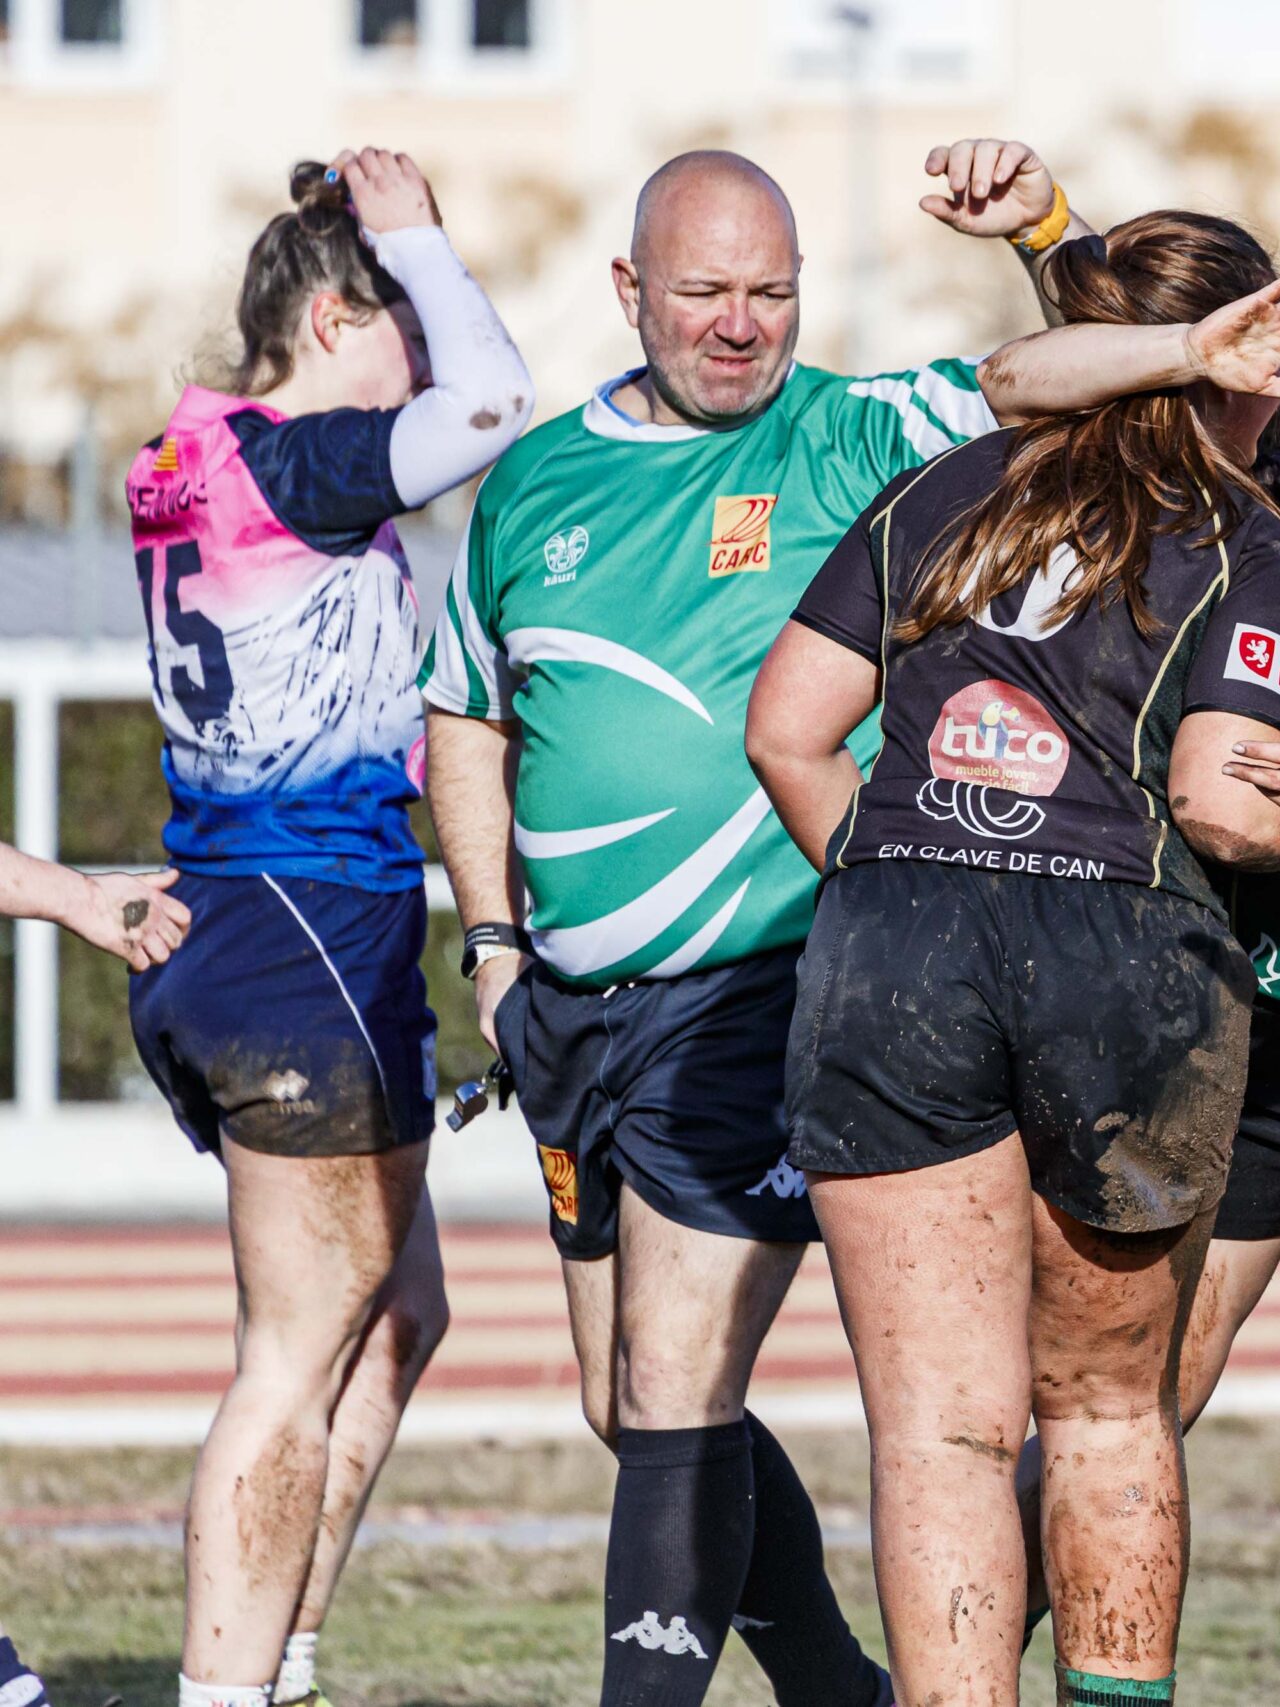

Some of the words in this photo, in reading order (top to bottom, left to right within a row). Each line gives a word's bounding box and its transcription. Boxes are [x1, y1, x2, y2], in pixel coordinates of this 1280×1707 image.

[941, 715, 1063, 764] tuco
[955, 764, 1000, 778] mueble
[878, 844, 913, 859] EN
[919, 846, 1002, 869] CLAVE
[1008, 852, 1043, 874] DE
[1049, 855, 1105, 881] CAN
